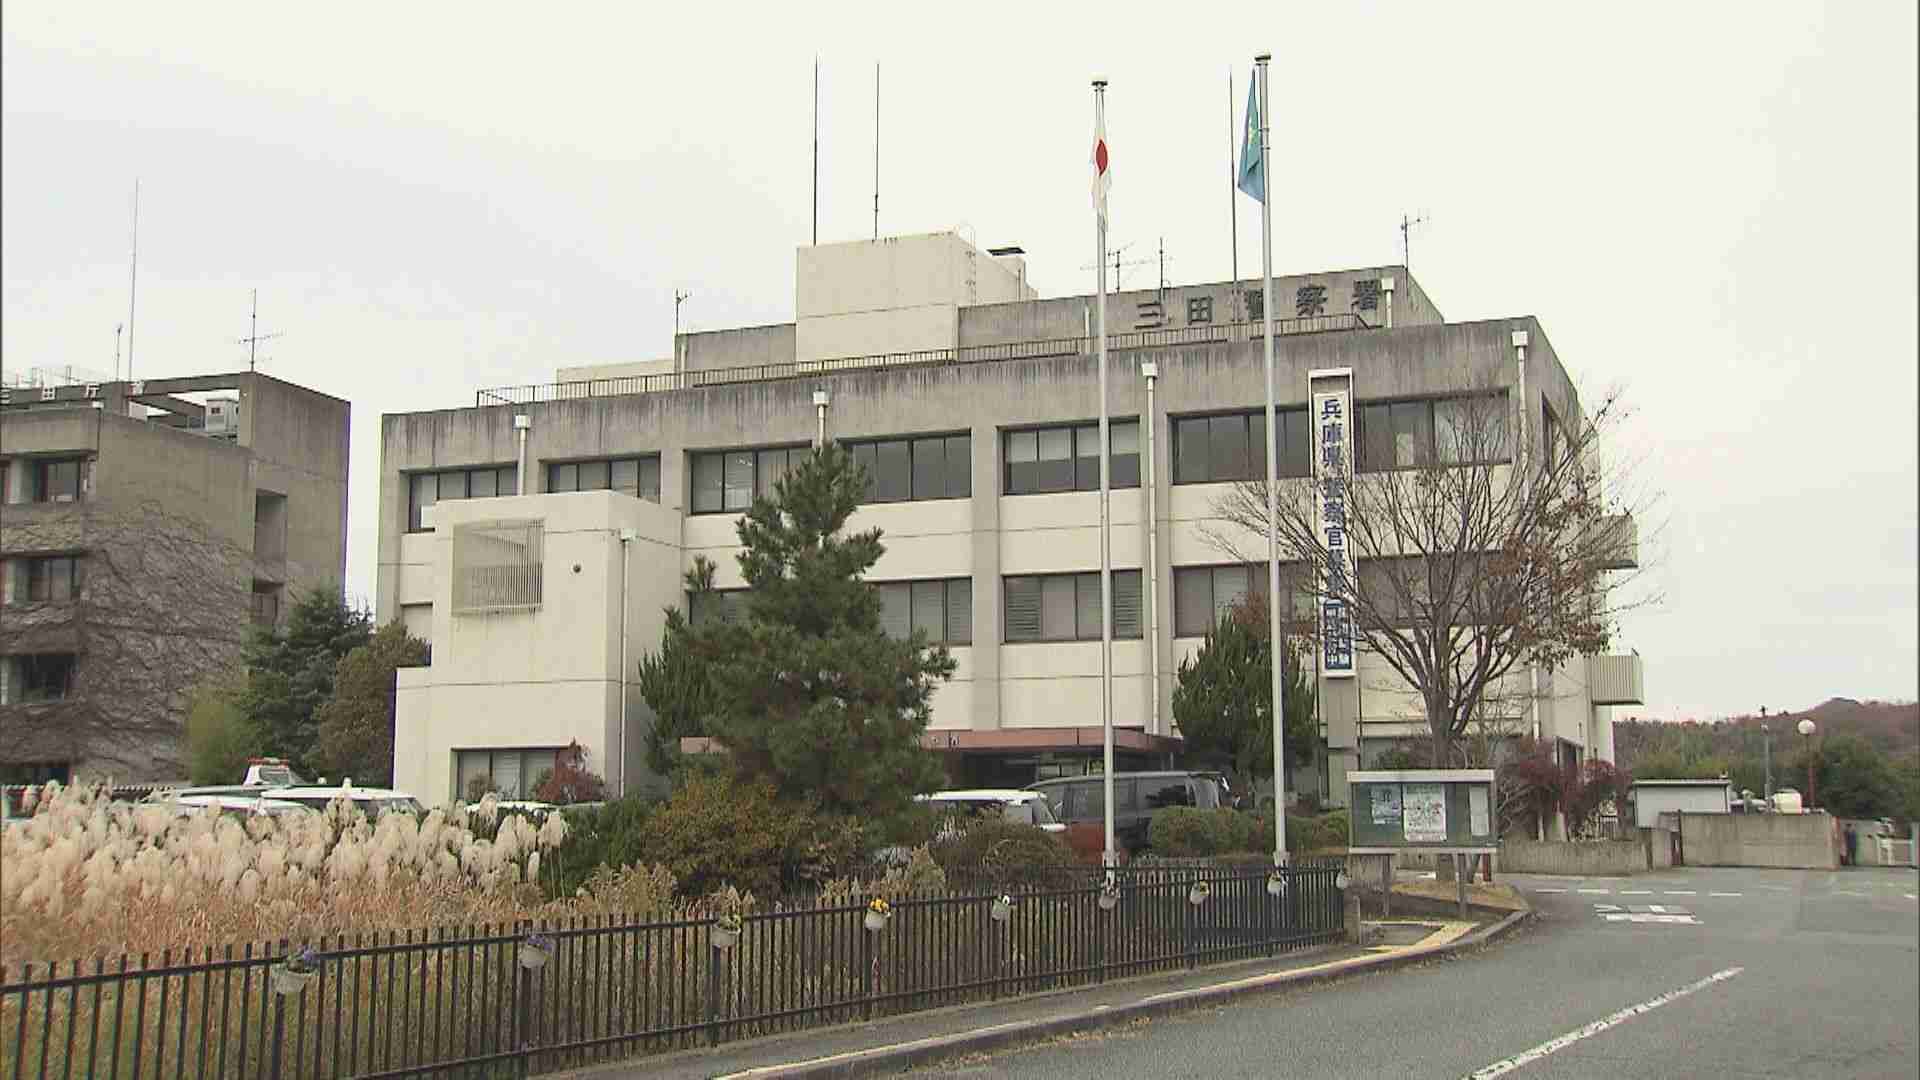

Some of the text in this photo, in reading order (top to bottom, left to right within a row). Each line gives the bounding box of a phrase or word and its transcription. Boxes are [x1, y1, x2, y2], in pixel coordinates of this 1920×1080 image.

[1321, 399, 1345, 594] 兵庫県察官
